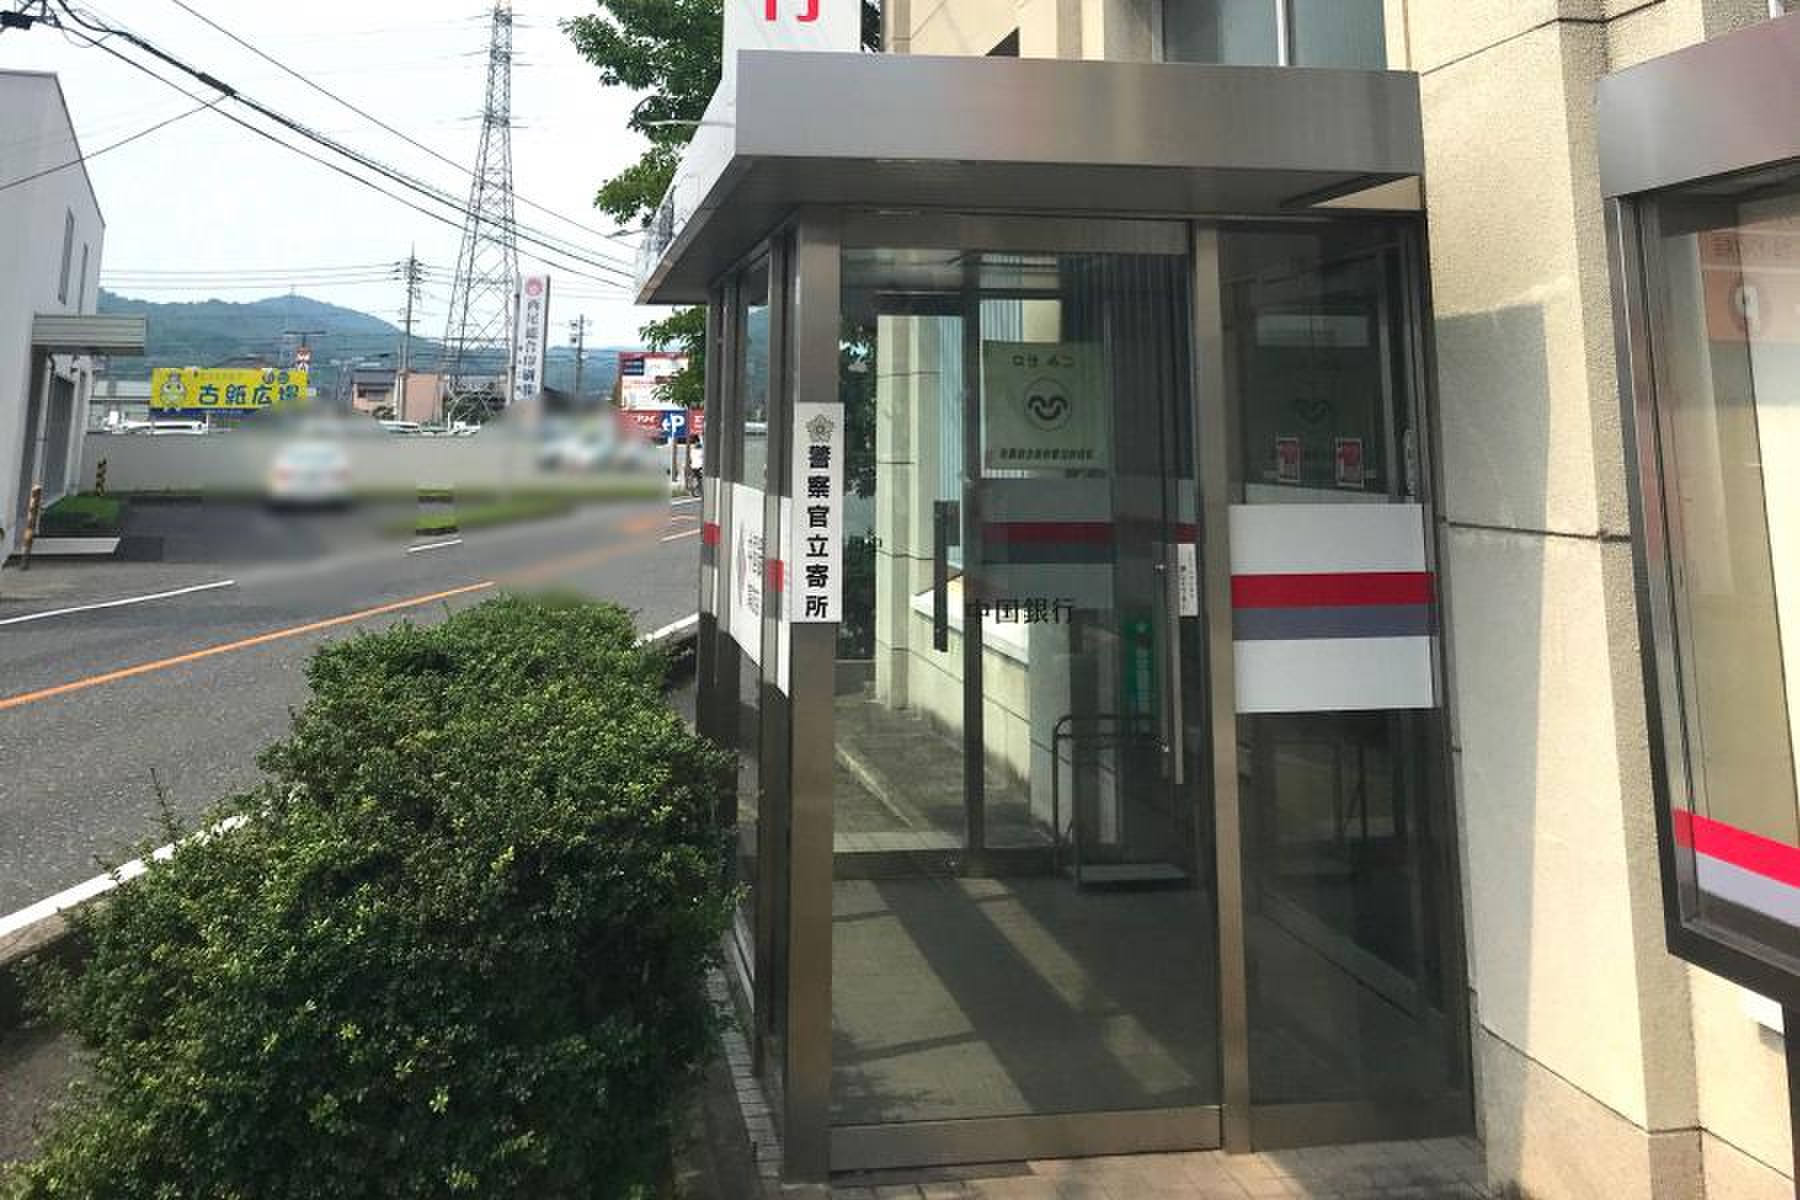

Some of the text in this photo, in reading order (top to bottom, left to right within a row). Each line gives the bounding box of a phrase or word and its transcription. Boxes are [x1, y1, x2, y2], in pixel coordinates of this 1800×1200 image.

[671, 414, 685, 433] P
[805, 444, 831, 619] 警察官立寄所
[966, 598, 1076, 624] 中国銀行
